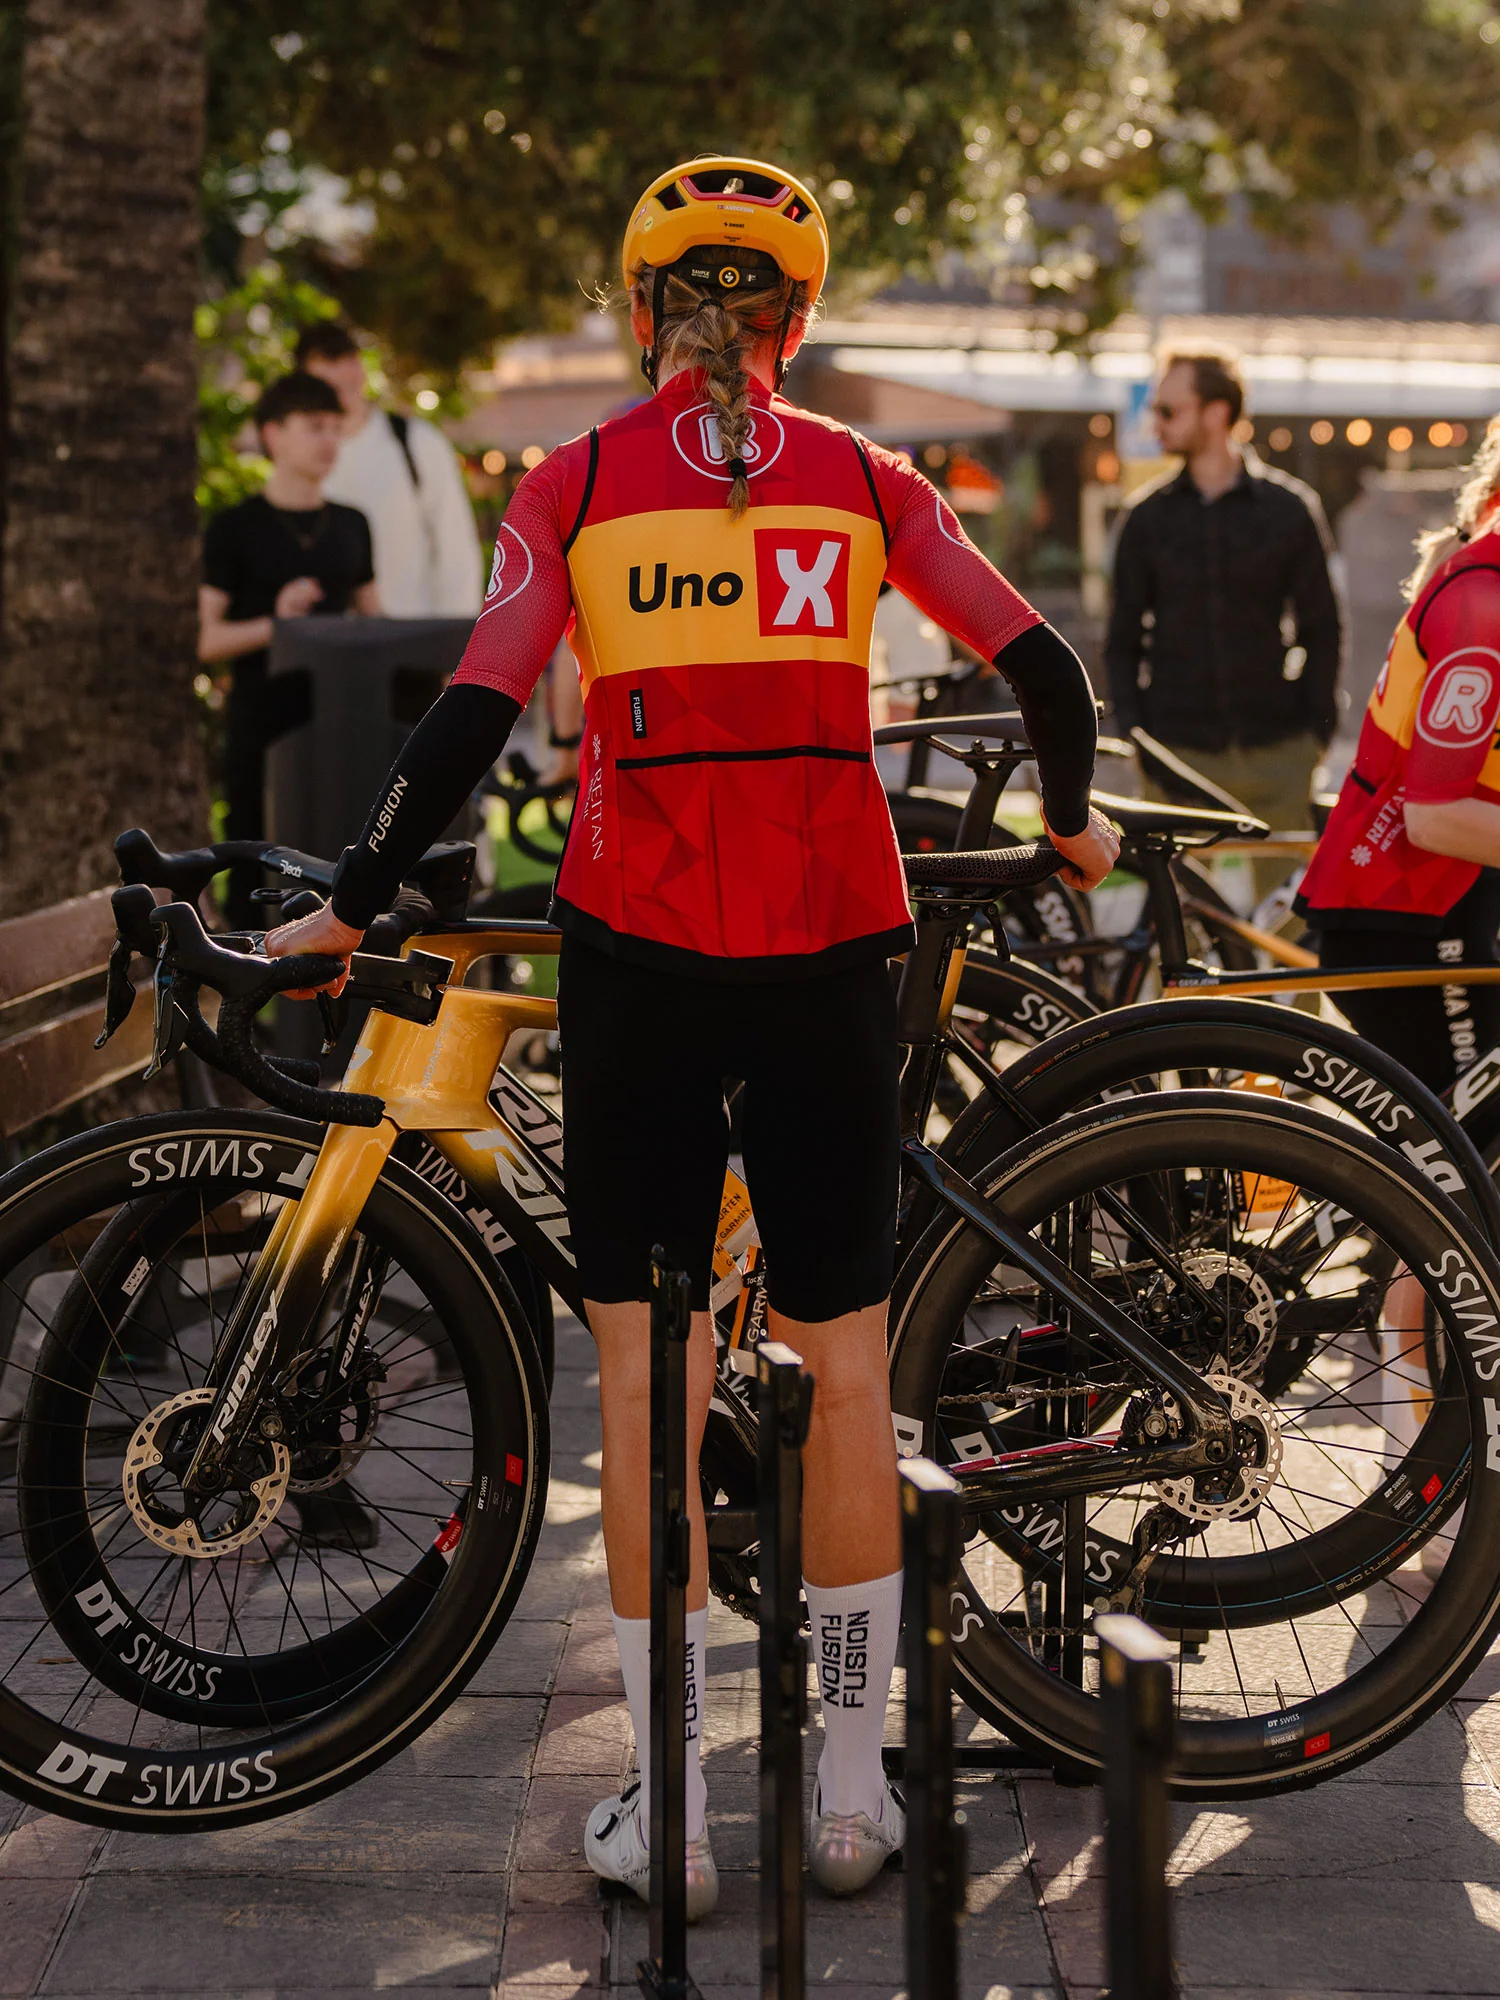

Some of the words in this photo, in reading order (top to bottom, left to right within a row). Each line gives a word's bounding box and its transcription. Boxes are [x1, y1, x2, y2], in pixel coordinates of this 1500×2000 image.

[628, 562, 744, 614] Uno
[772, 540, 843, 628] X
[632, 696, 644, 732] FUSION
[1428, 666, 1492, 734] R
[367, 774, 409, 853] FUSION
[590, 767, 604, 860] REITAN
[1294, 1047, 1415, 1132] SWISS
[955, 1107, 995, 1156] SCHWAL
[128, 1141, 273, 1187] SWISS
[1399, 1139, 1467, 1194] DT
[465, 1207, 517, 1255] DT
[719, 1206, 751, 1240] GARMIN
[339, 1267, 374, 1379] RIDLEY
[212, 1289, 279, 1445] RIDLEY
[477, 1498, 485, 1510] DT
[479, 1475, 489, 1498] SWISS
[442, 1541, 451, 1552] DT
[74, 1579, 131, 1638] DT
[120, 1632, 223, 1701] SWISS
[821, 1613, 841, 1707] FUSION
[842, 1609, 870, 1709] FUSION
[1267, 1720, 1279, 1728] DT
[1279, 1713, 1300, 1726] SWISS
[37, 1740, 128, 1797] DT
[132, 1750, 279, 1806] SWISS
[622, 1866, 650, 1882] SPHY
